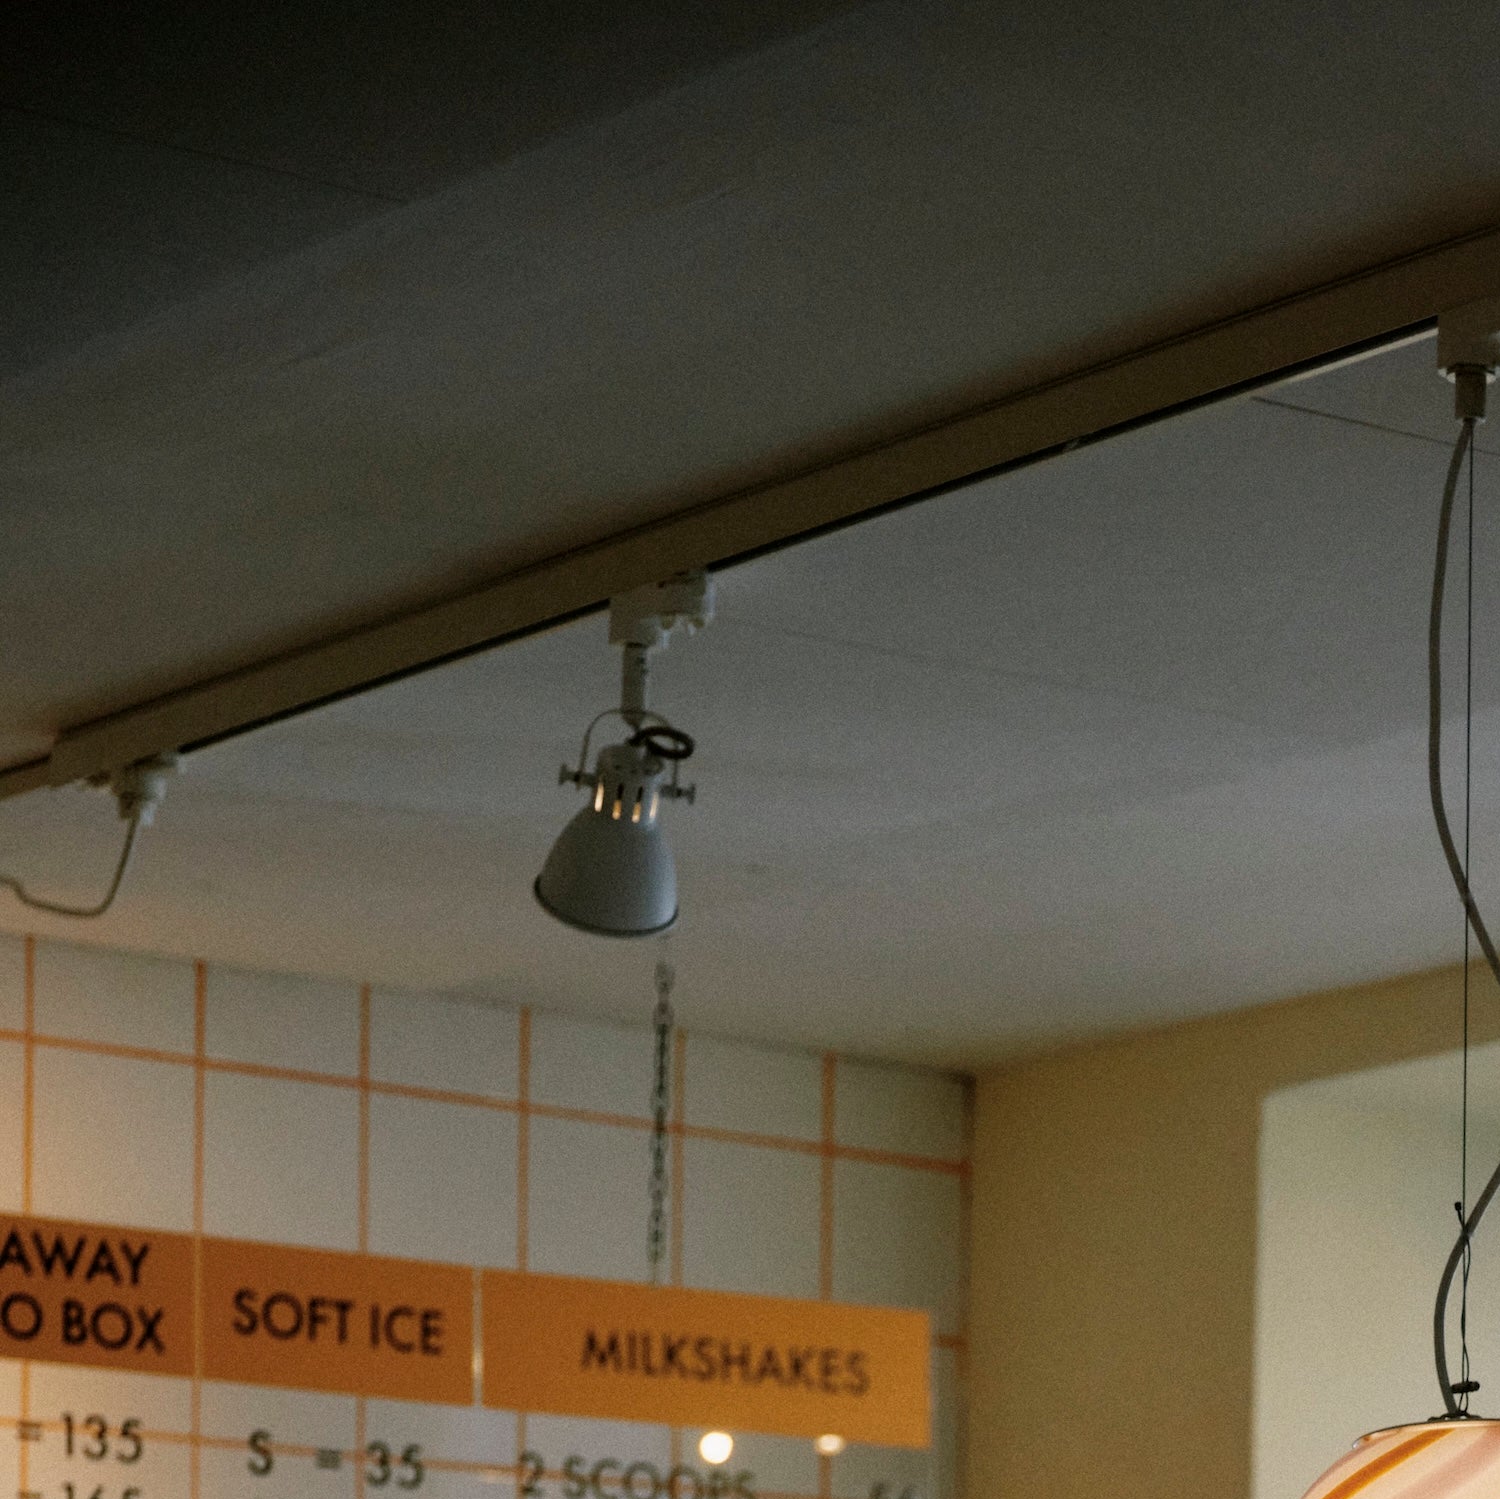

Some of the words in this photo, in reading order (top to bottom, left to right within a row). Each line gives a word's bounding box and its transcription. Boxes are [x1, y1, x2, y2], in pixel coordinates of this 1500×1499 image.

[0, 1230, 151, 1286] AWAY
[62, 1300, 165, 1354] BOX
[233, 1288, 352, 1345] SOFT
[370, 1306, 445, 1356] ICE
[580, 1330, 871, 1397] MILKSHAKES
[62, 1412, 144, 1465] 135
[248, 1429, 274, 1478] S
[366, 1441, 424, 1490] 35
[520, 1451, 544, 1498] 2
